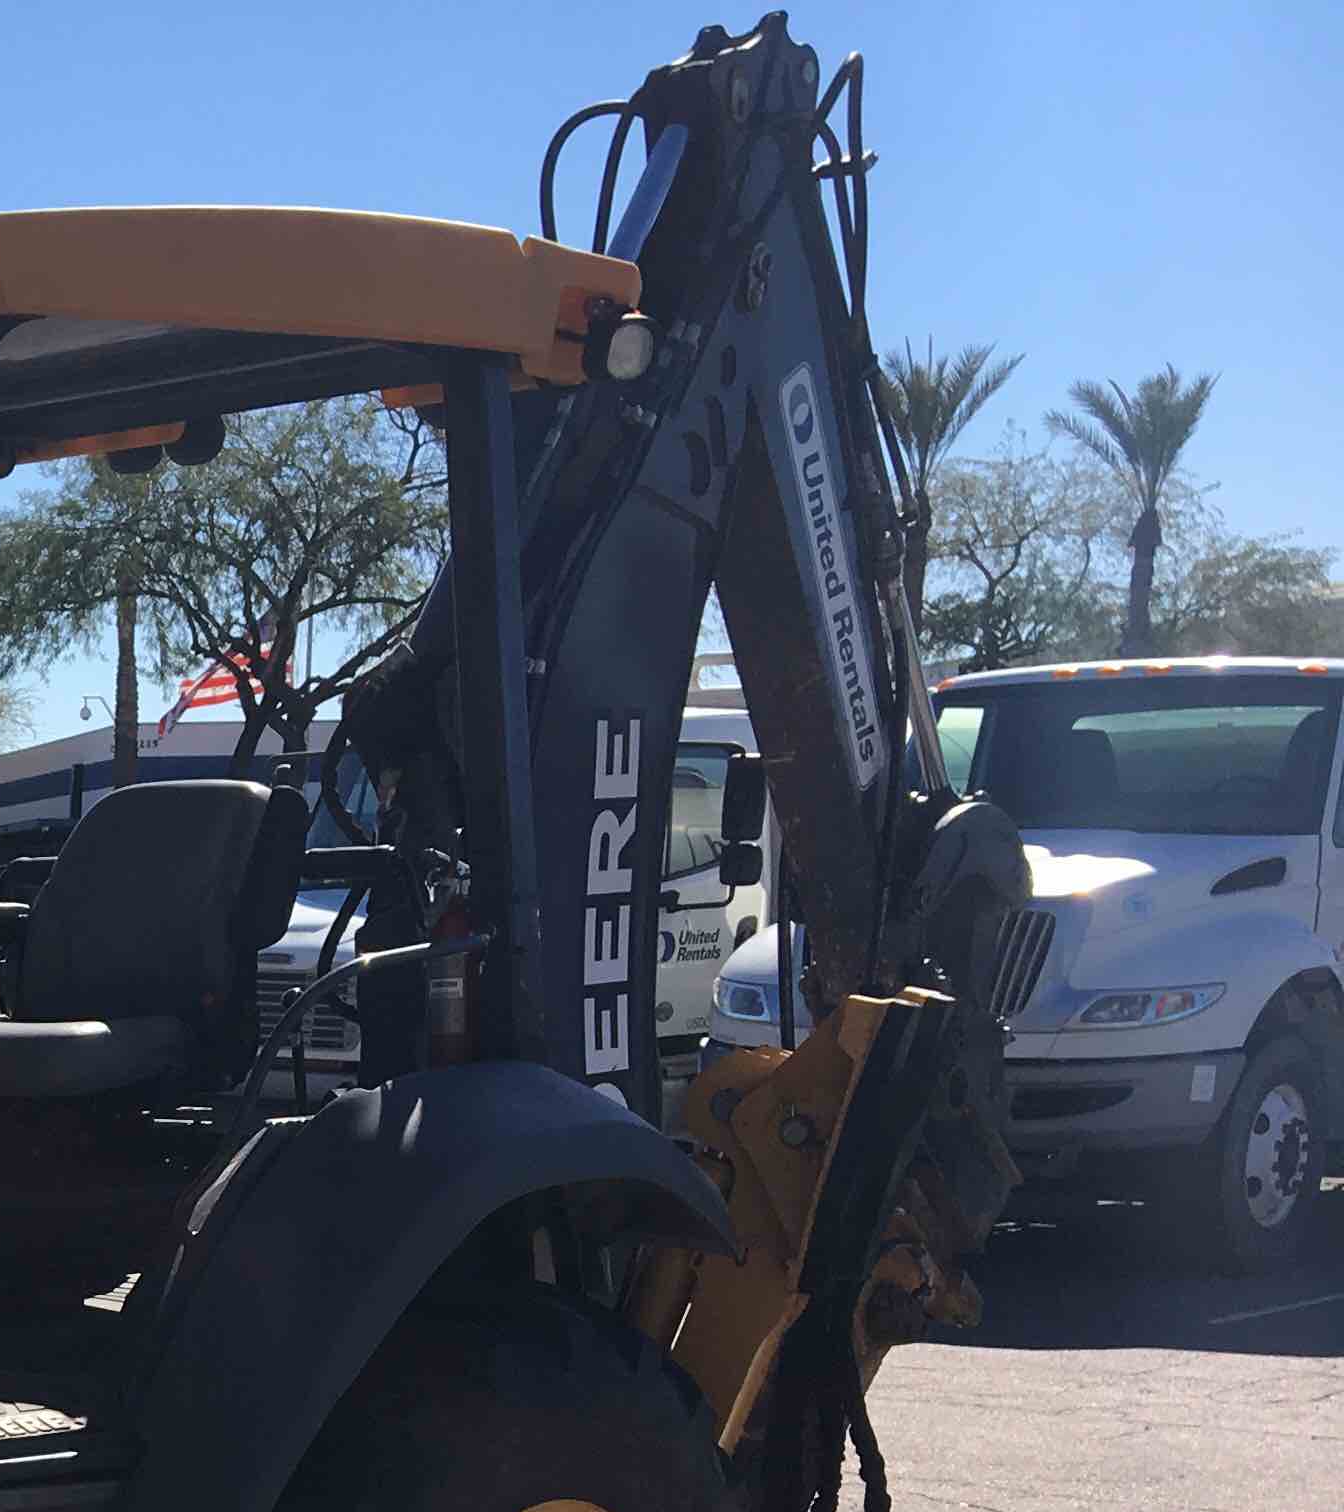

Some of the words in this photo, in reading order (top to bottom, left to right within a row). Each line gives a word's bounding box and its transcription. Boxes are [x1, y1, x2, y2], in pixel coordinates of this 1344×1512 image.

[801, 451, 845, 600] United
[832, 606, 875, 763] Rentals
[584, 718, 641, 1111] EERE
[677, 945, 720, 961] Rentals
[679, 928, 720, 945] United
